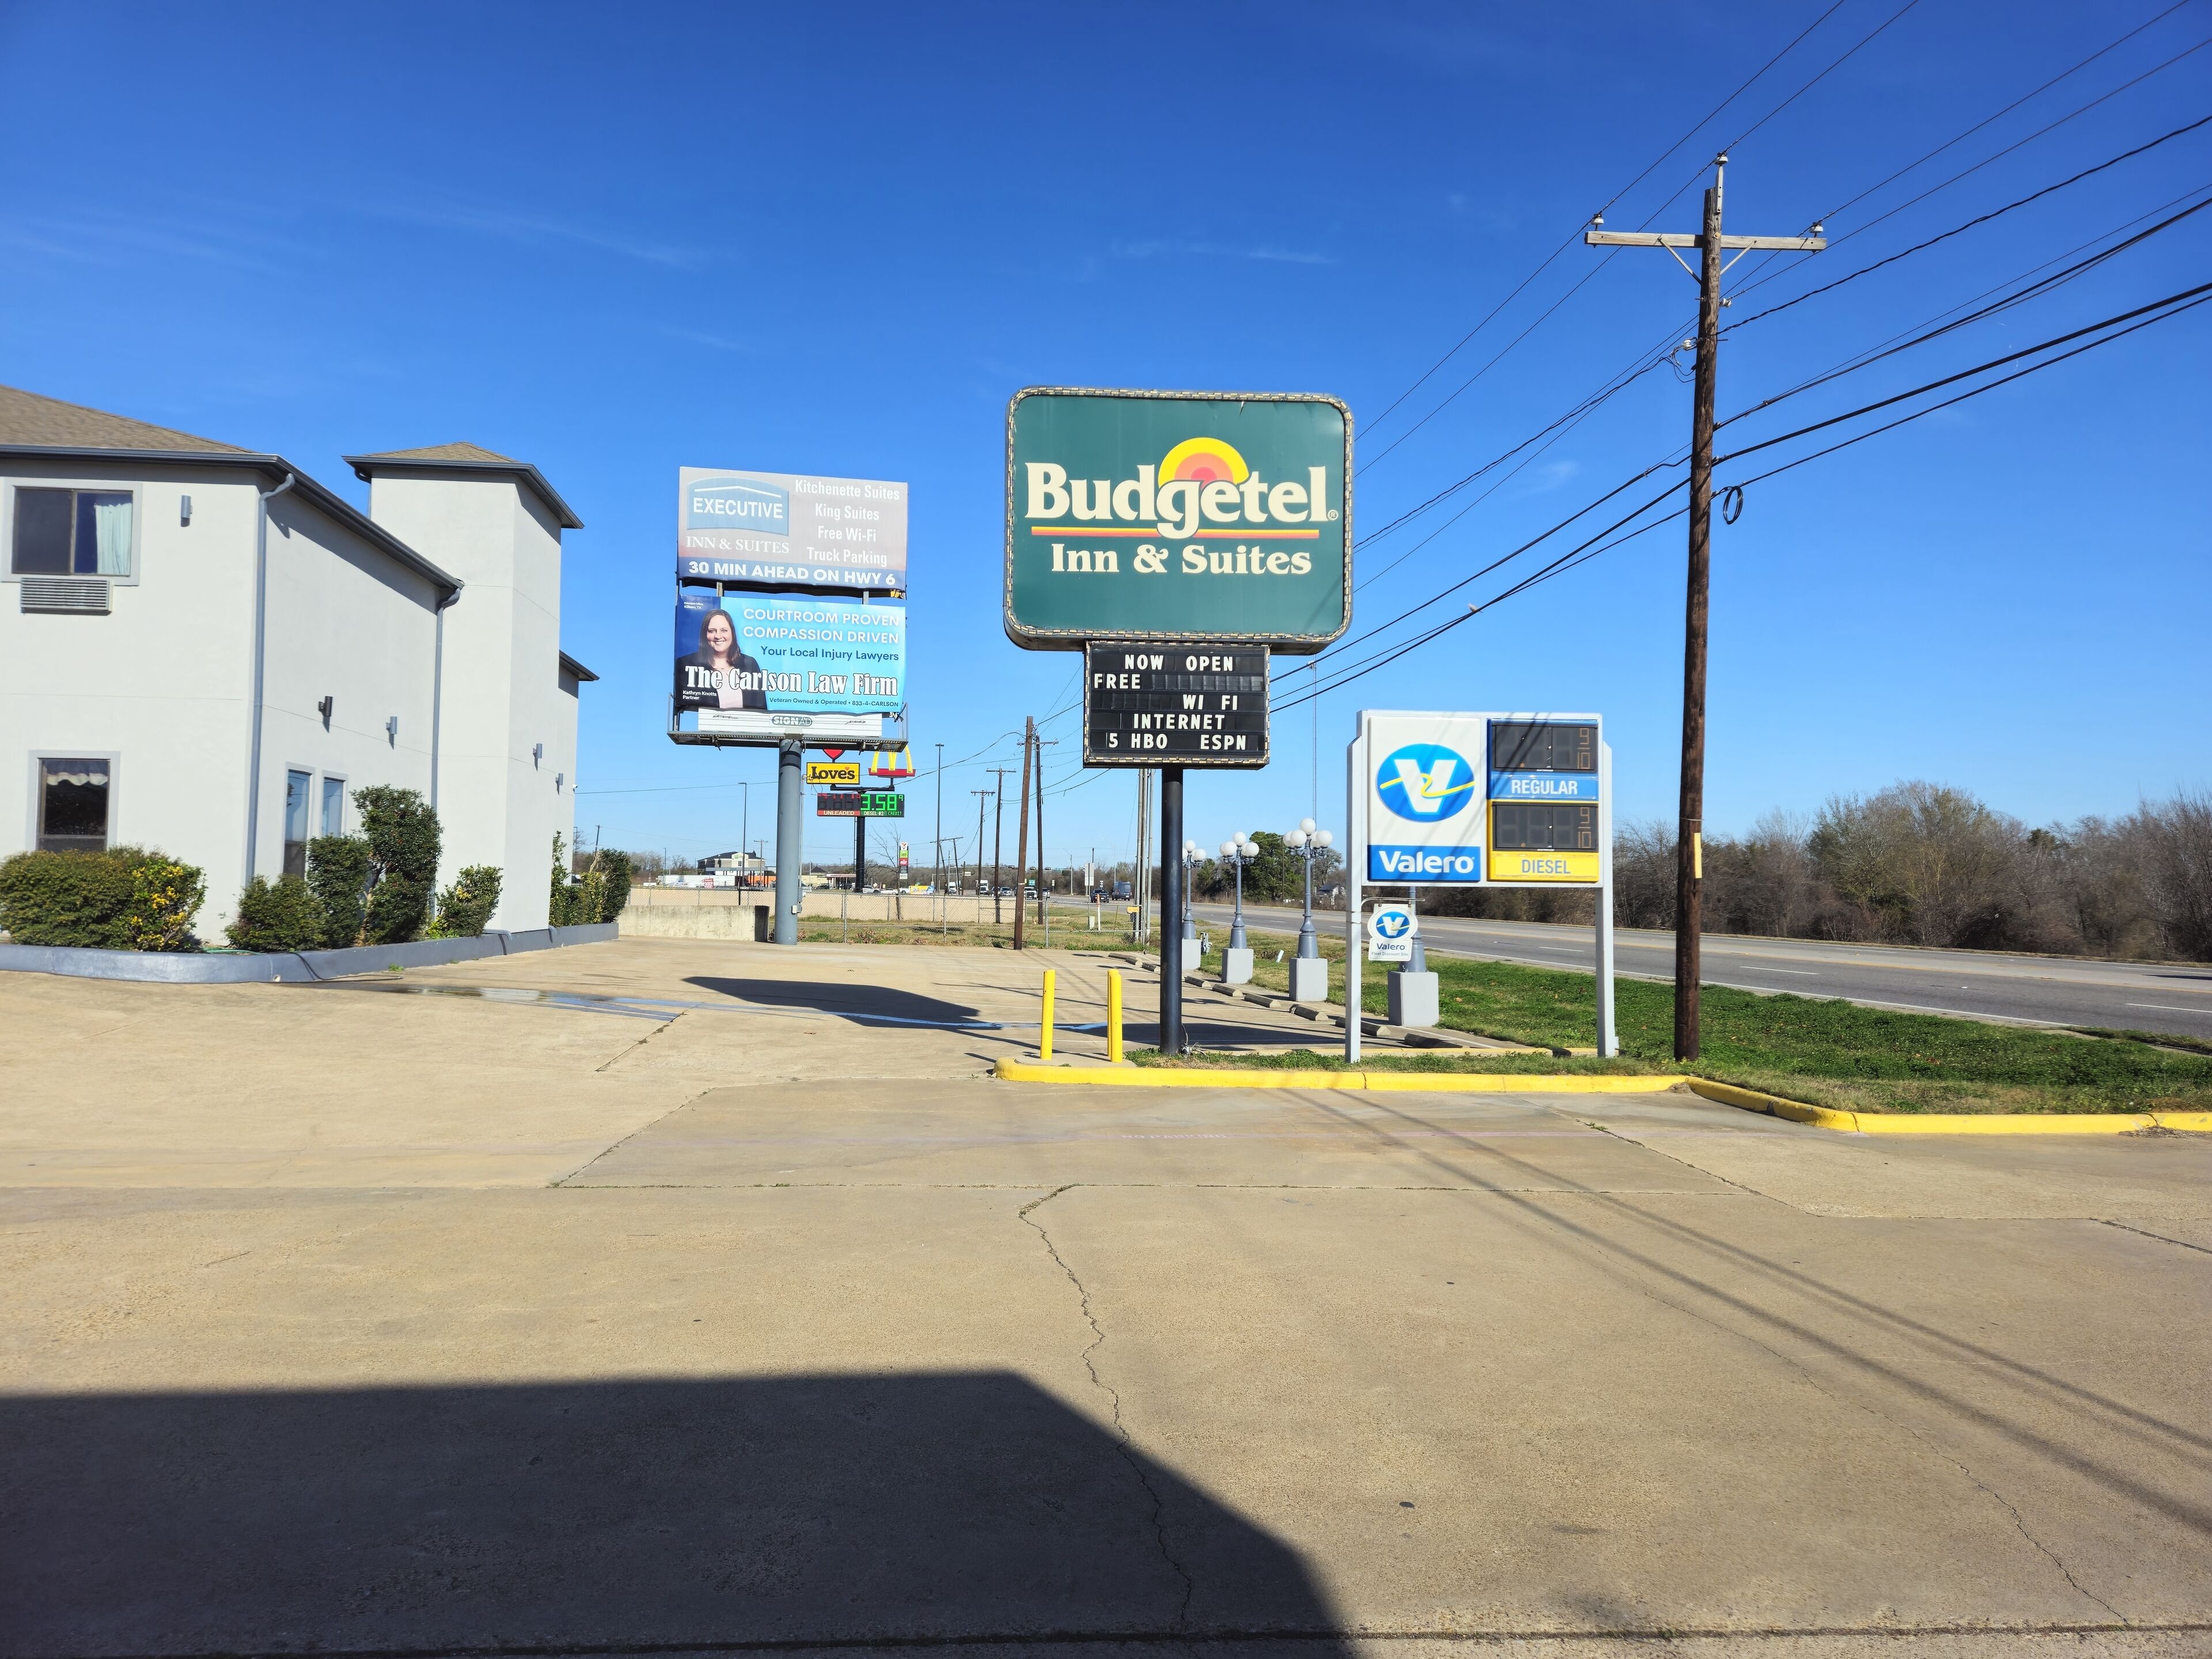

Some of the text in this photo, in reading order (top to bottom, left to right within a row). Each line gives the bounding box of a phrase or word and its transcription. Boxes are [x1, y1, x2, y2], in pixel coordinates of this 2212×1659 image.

[795, 479, 900, 500] Kitchenette Suites
[692, 497, 783, 519] EXECUTIVE
[1024, 462, 1330, 540] Budgetel
[815, 503, 880, 521] King Suites
[817, 525, 876, 542] Free Wi-Fi
[685, 535, 789, 554] INN & SUITES
[806, 546, 888, 567] Truck Parking
[1051, 543, 1312, 575] Inn & Suites
[688, 560, 896, 585] 30 MIN AHEAD ON HWY 6
[744, 608, 899, 627] COURTROOM PROVEN
[743, 626, 899, 644] COMPASSION DRIVEN
[760, 646, 899, 662] Your Local Injury Lawyers
[1124, 654, 1233, 671] NOW OPEN
[685, 665, 898, 696] The Carlson Law Firm
[1094, 673, 1141, 690] FREE
[1183, 694, 1238, 710] WI FI
[1134, 713, 1225, 730] INTERNET
[1109, 733, 1246, 750] 5 HBO ESPN
[1510, 779, 1578, 796] REGULAR
[1378, 850, 1474, 873] Valero
[1522, 859, 1571, 874] DIESEL
